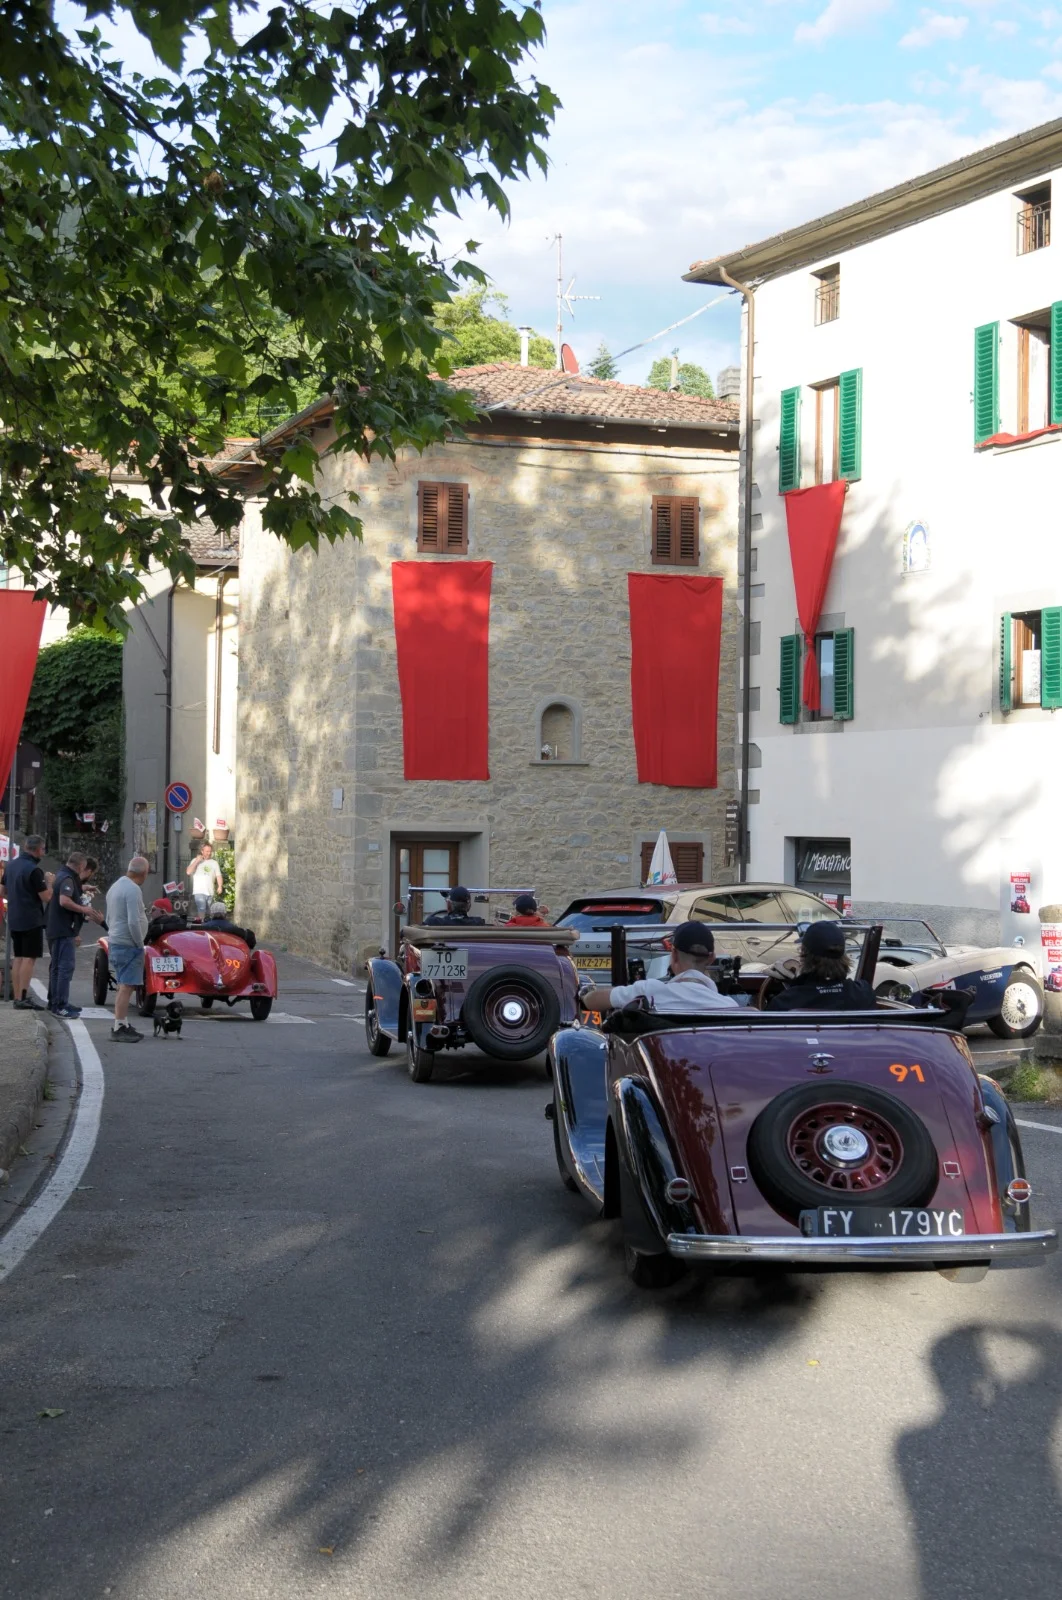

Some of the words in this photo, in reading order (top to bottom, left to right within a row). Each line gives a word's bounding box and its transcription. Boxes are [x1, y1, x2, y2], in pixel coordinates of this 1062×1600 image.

[437, 952, 452, 963] TO
[577, 959, 611, 968] HKZ-27-F
[428, 965, 466, 976] 77123R
[582, 1011, 601, 1025] 73
[889, 1063, 925, 1082] 91
[823, 1210, 853, 1235] FY
[889, 1210, 963, 1237] 179YC
